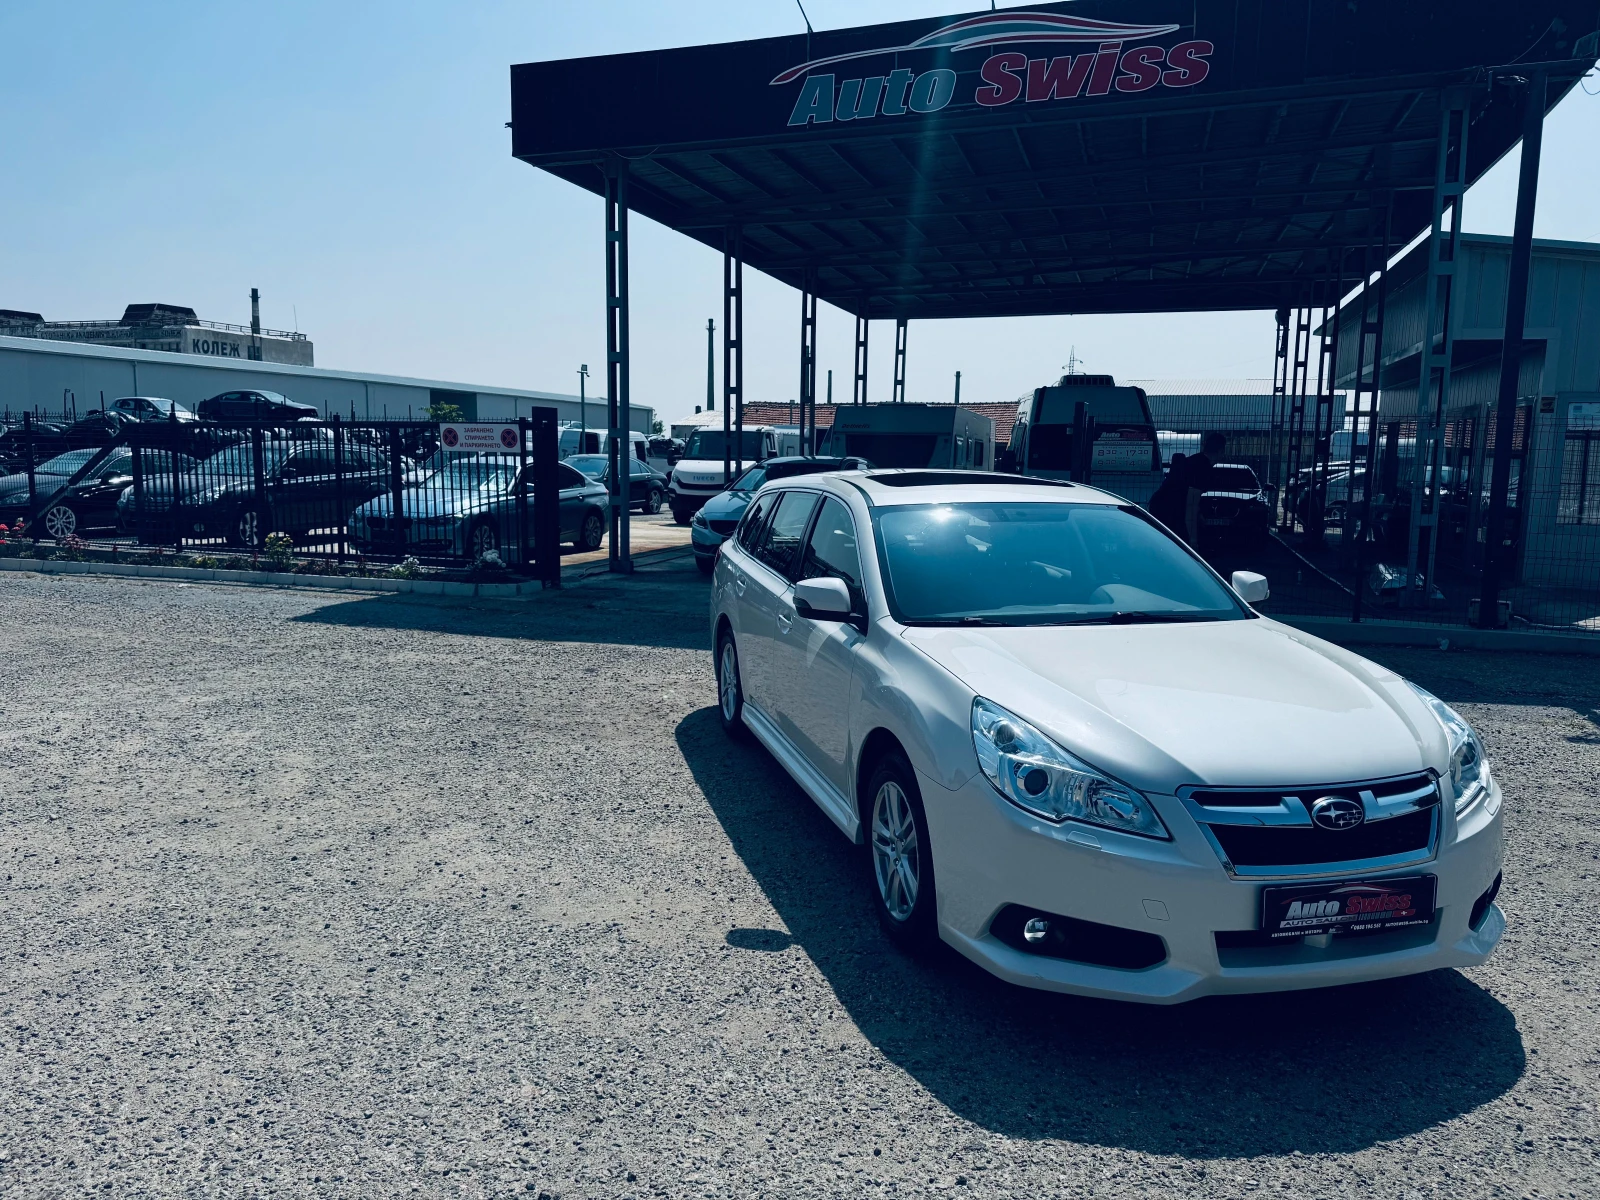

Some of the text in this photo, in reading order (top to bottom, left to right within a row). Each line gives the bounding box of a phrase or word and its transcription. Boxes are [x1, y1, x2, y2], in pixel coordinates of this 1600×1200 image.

[786, 40, 1215, 127] Auto Swiss
[192, 338, 241, 358] КОЛЕЖ
[1286, 894, 1412, 919] Auto Swiss
[1283, 919, 1314, 927] AUTO
